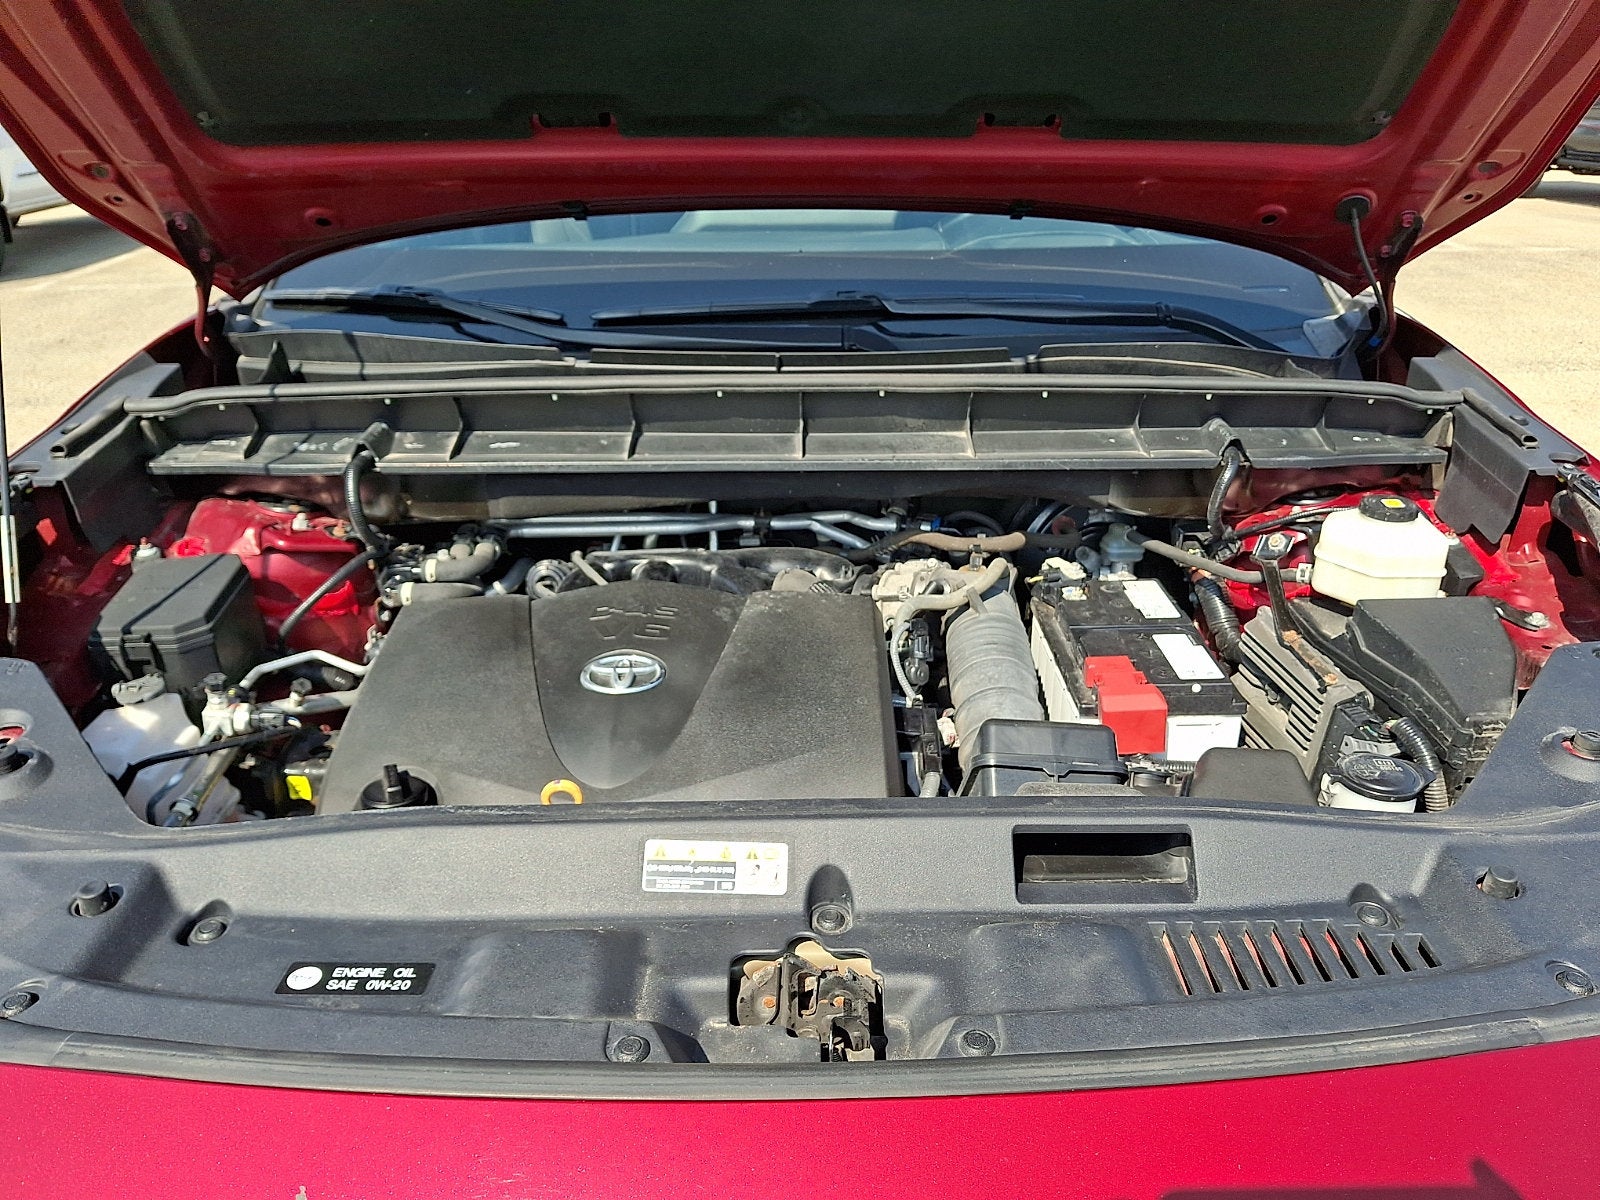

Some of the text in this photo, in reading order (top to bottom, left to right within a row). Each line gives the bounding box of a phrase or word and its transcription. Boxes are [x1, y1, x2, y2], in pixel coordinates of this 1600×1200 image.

[331, 967, 417, 978] ENGINE OIL
[325, 979, 411, 991] SAE 0W-20
